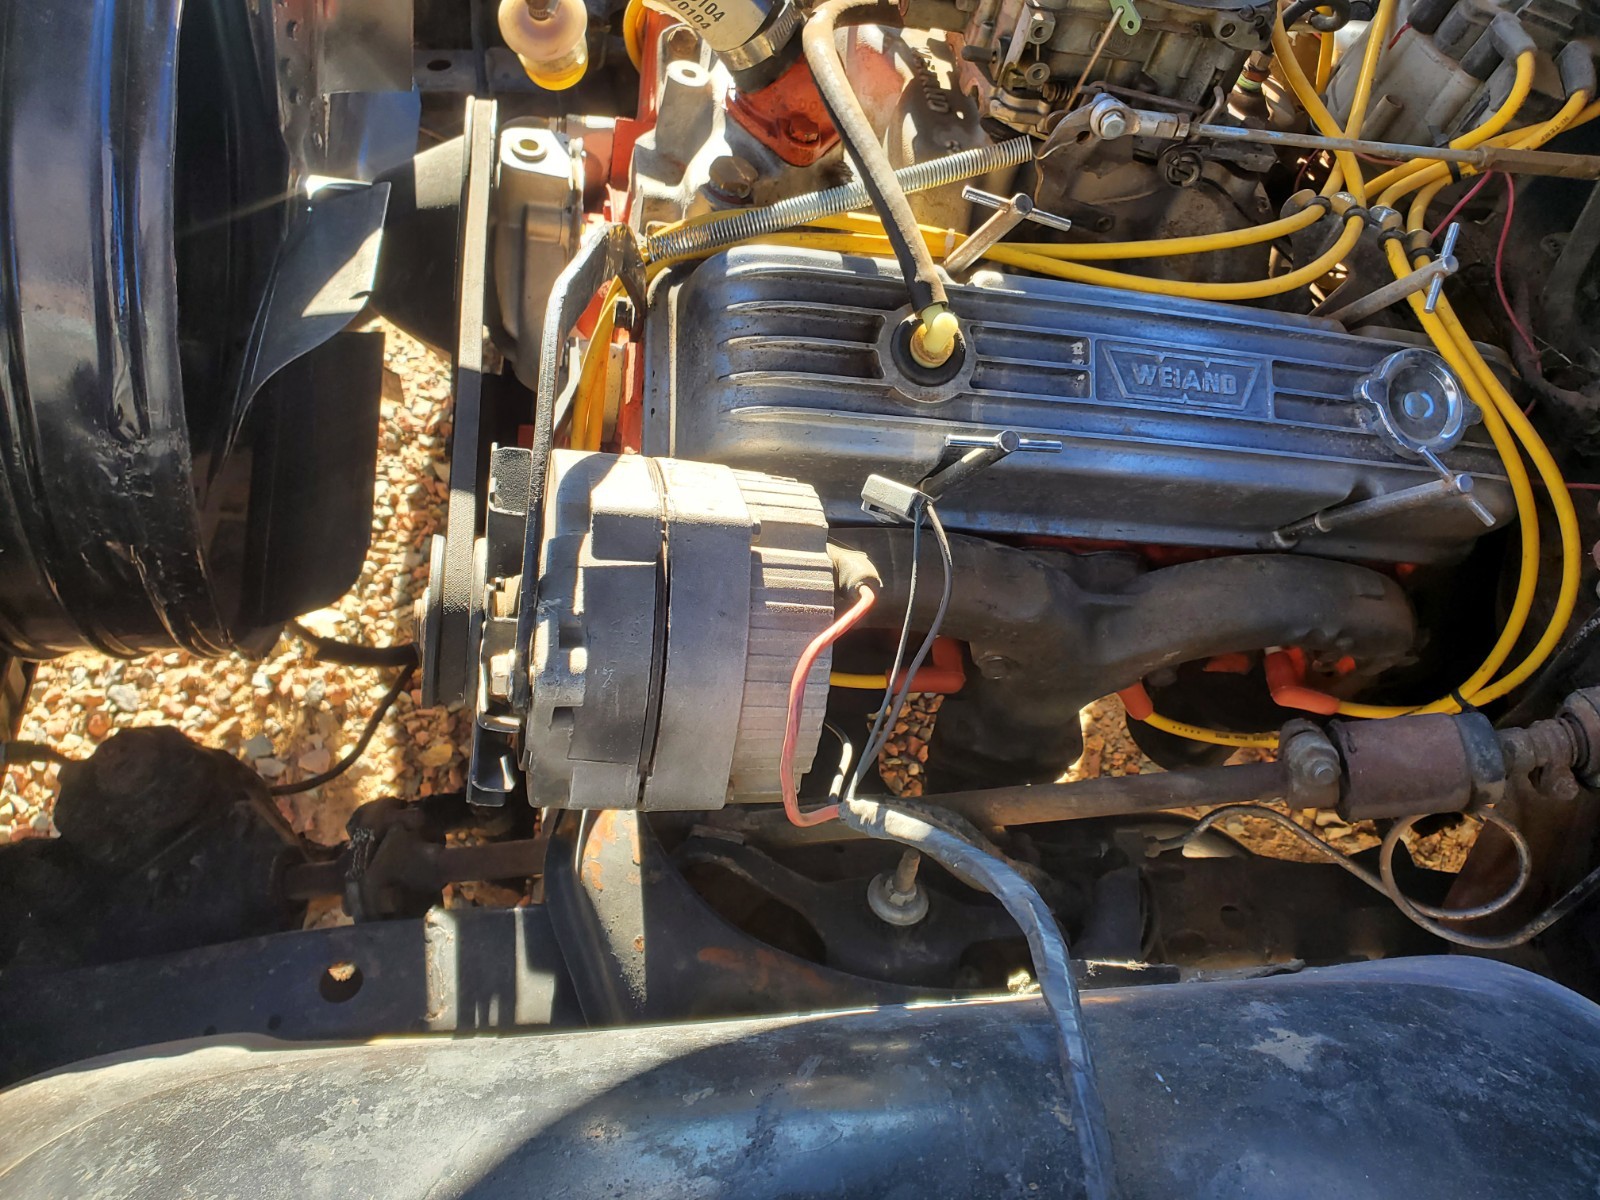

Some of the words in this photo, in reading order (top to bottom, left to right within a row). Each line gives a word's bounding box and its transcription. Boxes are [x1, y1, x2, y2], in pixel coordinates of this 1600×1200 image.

[670, 0, 711, 30] 0104
[691, 0, 725, 22] 104
[1132, 363, 1238, 395] WEIAND
